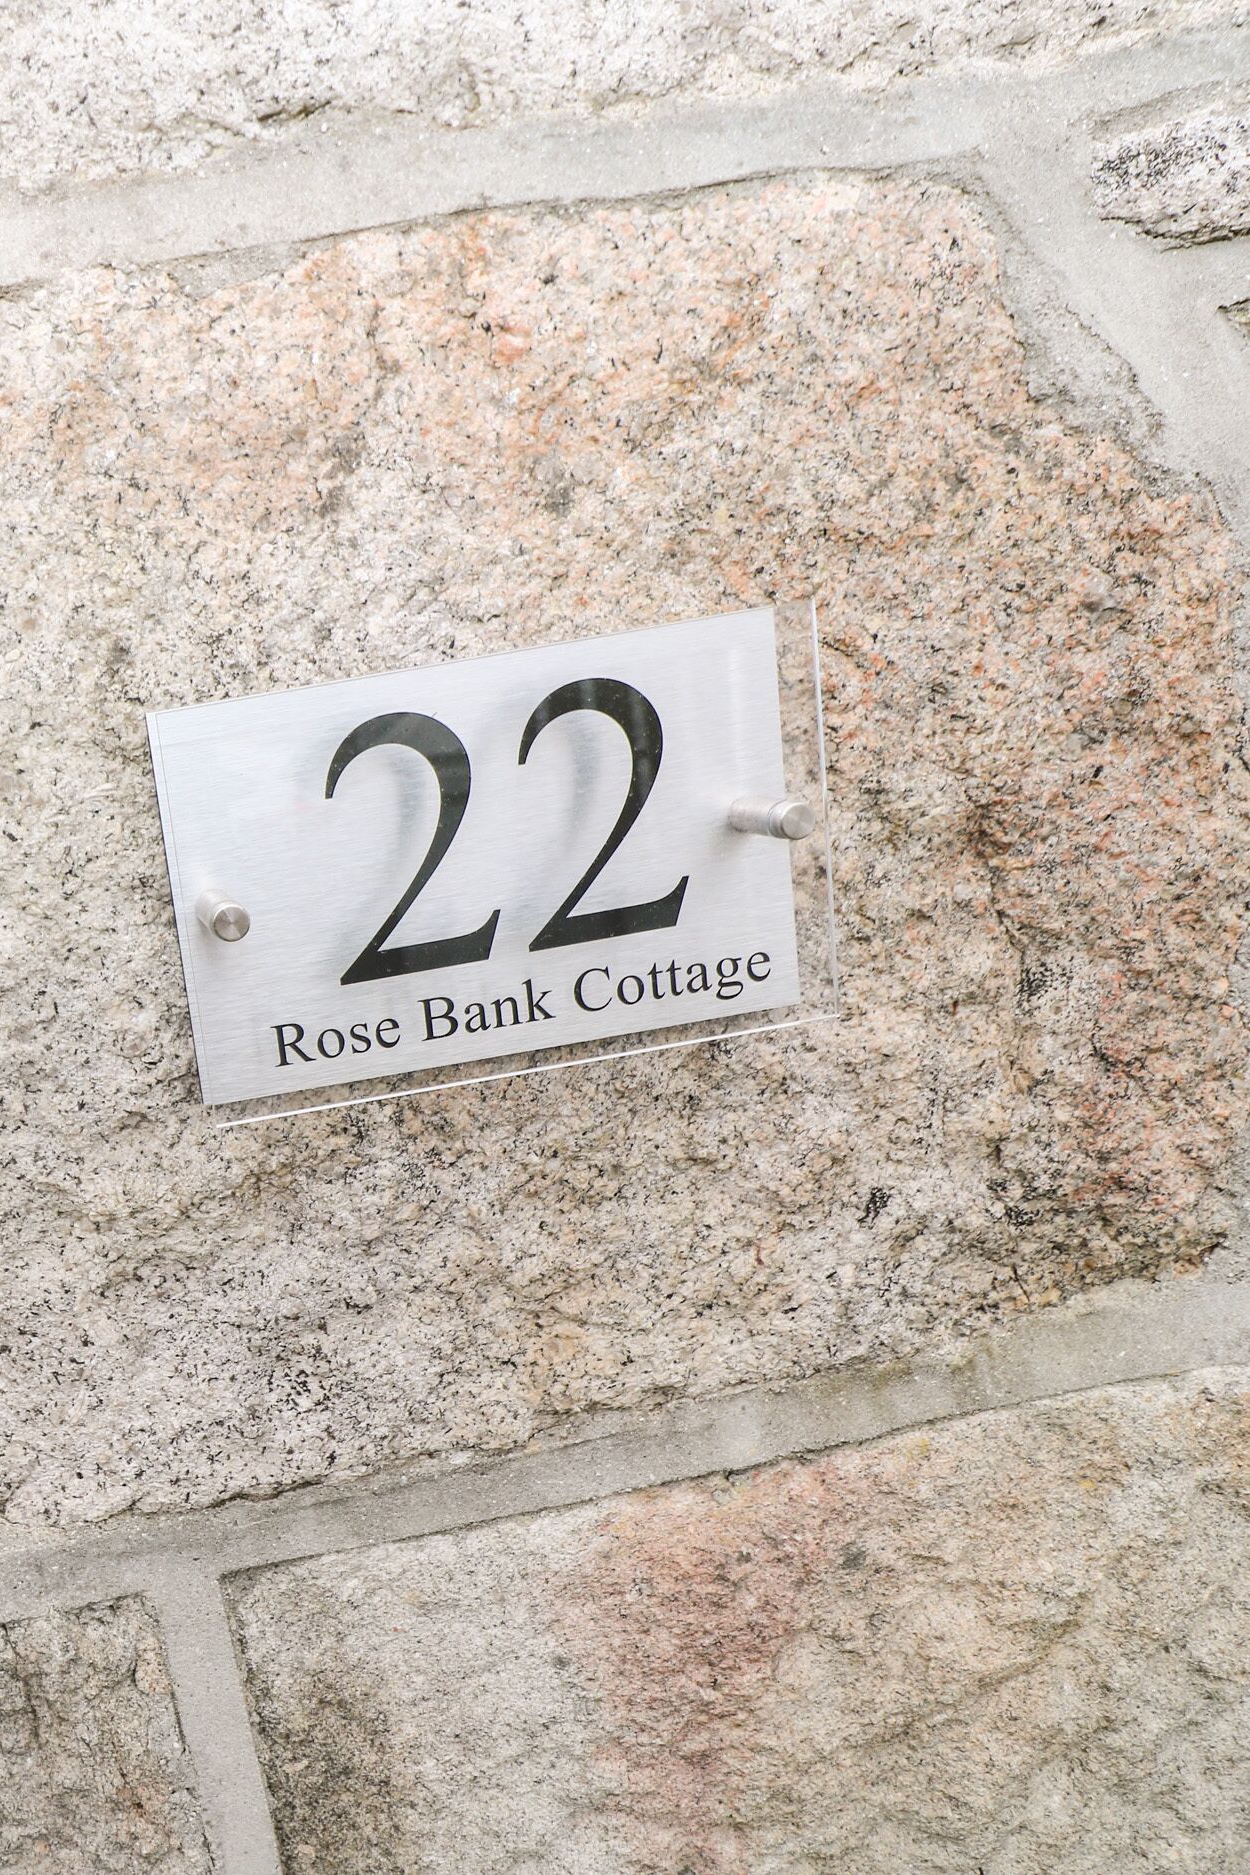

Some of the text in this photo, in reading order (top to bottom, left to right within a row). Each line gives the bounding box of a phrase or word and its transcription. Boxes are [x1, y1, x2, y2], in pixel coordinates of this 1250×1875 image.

[325, 677, 690, 986] 22
[270, 950, 772, 1068] Rose Bank Cottage
